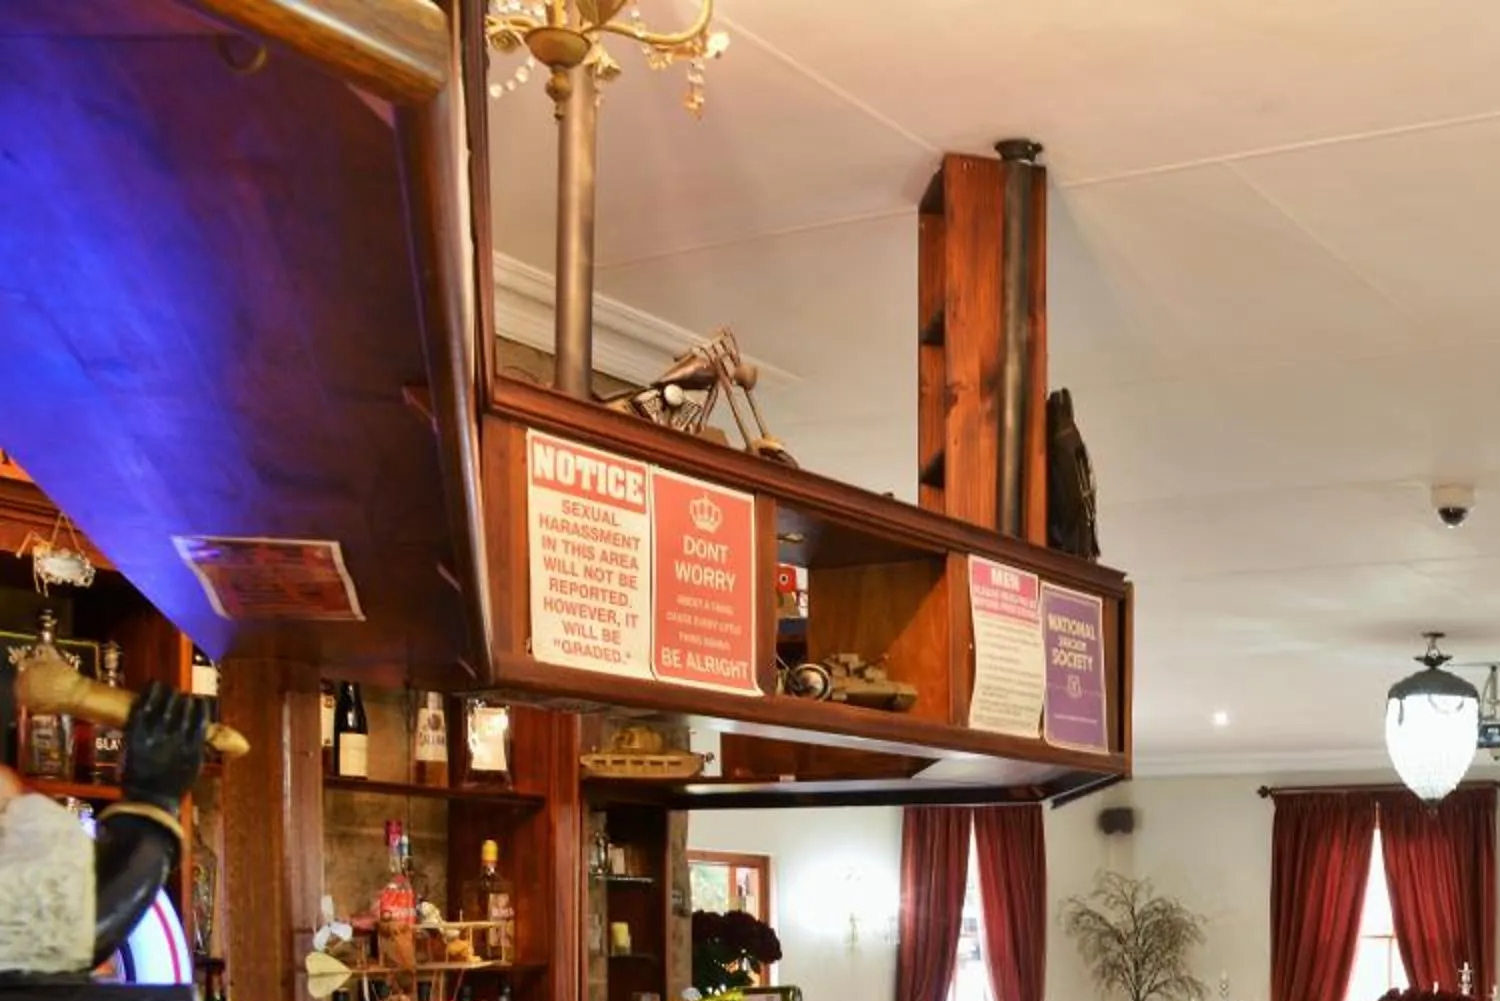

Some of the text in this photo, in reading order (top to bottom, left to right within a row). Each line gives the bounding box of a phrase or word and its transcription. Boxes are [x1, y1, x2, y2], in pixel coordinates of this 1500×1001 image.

[534, 441, 644, 505] NOTICE
[562, 499, 620, 526] SEXUAL
[539, 512, 641, 550] HARASSMENT
[542, 534, 638, 570] IN THIS AREA
[683, 534, 729, 565] DONT
[543, 555, 638, 590] WILL NOT BE
[674, 560, 736, 592] WORRY
[549, 577, 632, 608] REPORTED.
[543, 596, 639, 629] HOWEVER, IT
[1048, 612, 1095, 640] NATIONAL
[562, 620, 621, 645] WILL BE
[661, 646, 749, 680] BE ALRIGHT
[1052, 647, 1093, 672] SOCIETY
